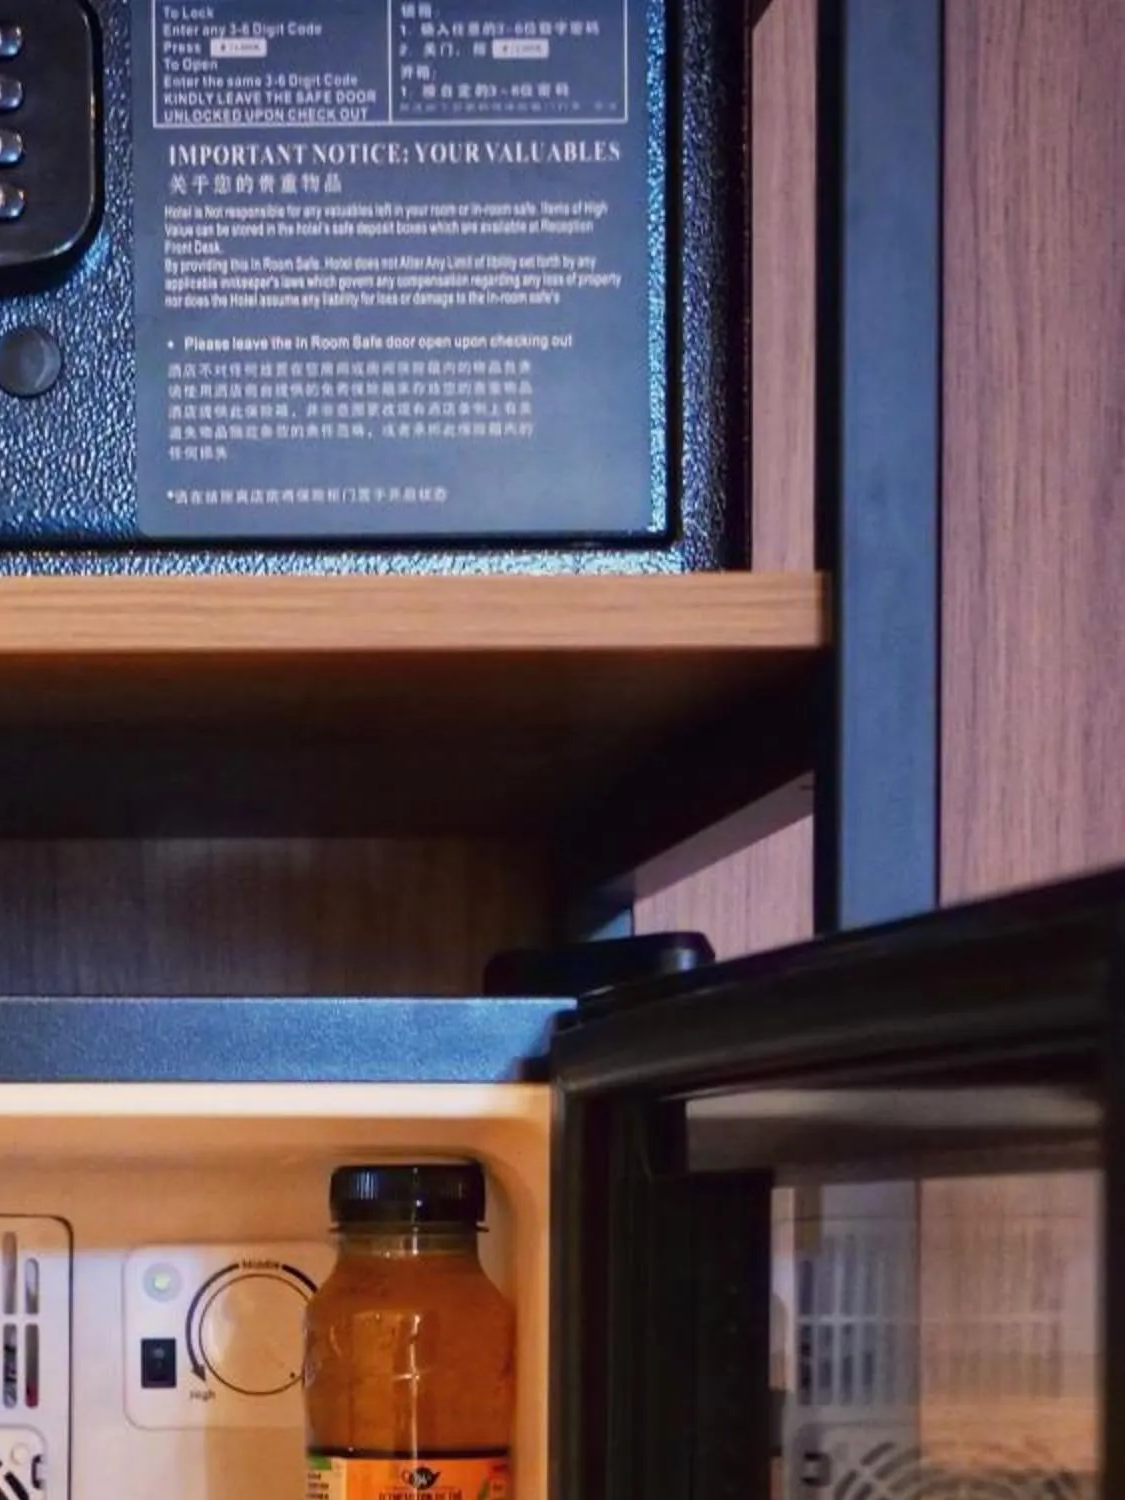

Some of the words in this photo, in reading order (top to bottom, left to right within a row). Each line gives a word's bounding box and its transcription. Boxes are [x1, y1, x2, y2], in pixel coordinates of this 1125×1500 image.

[163, 6, 179, 20] To
[183, 6, 215, 19] Lock
[163, 23, 200, 37] Enter
[203, 25, 225, 39] any
[252, 22, 284, 38] Digit
[288, 22, 323, 35] Code
[163, 41, 201, 55] Press
[163, 59, 179, 72] To
[183, 58, 218, 73] Open
[163, 75, 200, 89] Enter
[203, 75, 224, 88] the
[226, 77, 262, 87] same
[289, 73, 321, 89] Digit
[325, 73, 358, 86] Code
[164, 92, 213, 106] KINDLY
[218, 91, 261, 105] LEAVE
[265, 91, 291, 104] THE
[296, 90, 332, 104] SAFE
[336, 89, 377, 103] DOOR
[164, 109, 242, 122] UNLOCKED
[246, 108, 283, 122] UPON
[288, 108, 336, 121] CHECK
[340, 107, 368, 121] OUT
[168, 142, 308, 166] IMPORTANT
[313, 142, 410, 165] NOTICE:
[416, 141, 480, 164] YOUR
[486, 140, 623, 163] VALUABLES
[169, 173, 343, 195] 关于您的贵重物品
[184, 337, 229, 349] Please
[232, 337, 268, 349] leave
[271, 337, 291, 349] the
[296, 337, 308, 349] In
[311, 337, 349, 348] Room
[352, 336, 382, 348] Safe
[386, 336, 414, 348] door
[419, 339, 451, 350] open
[454, 339, 487, 350] upon
[490, 336, 548, 350] checking
[552, 336, 573, 348] out
